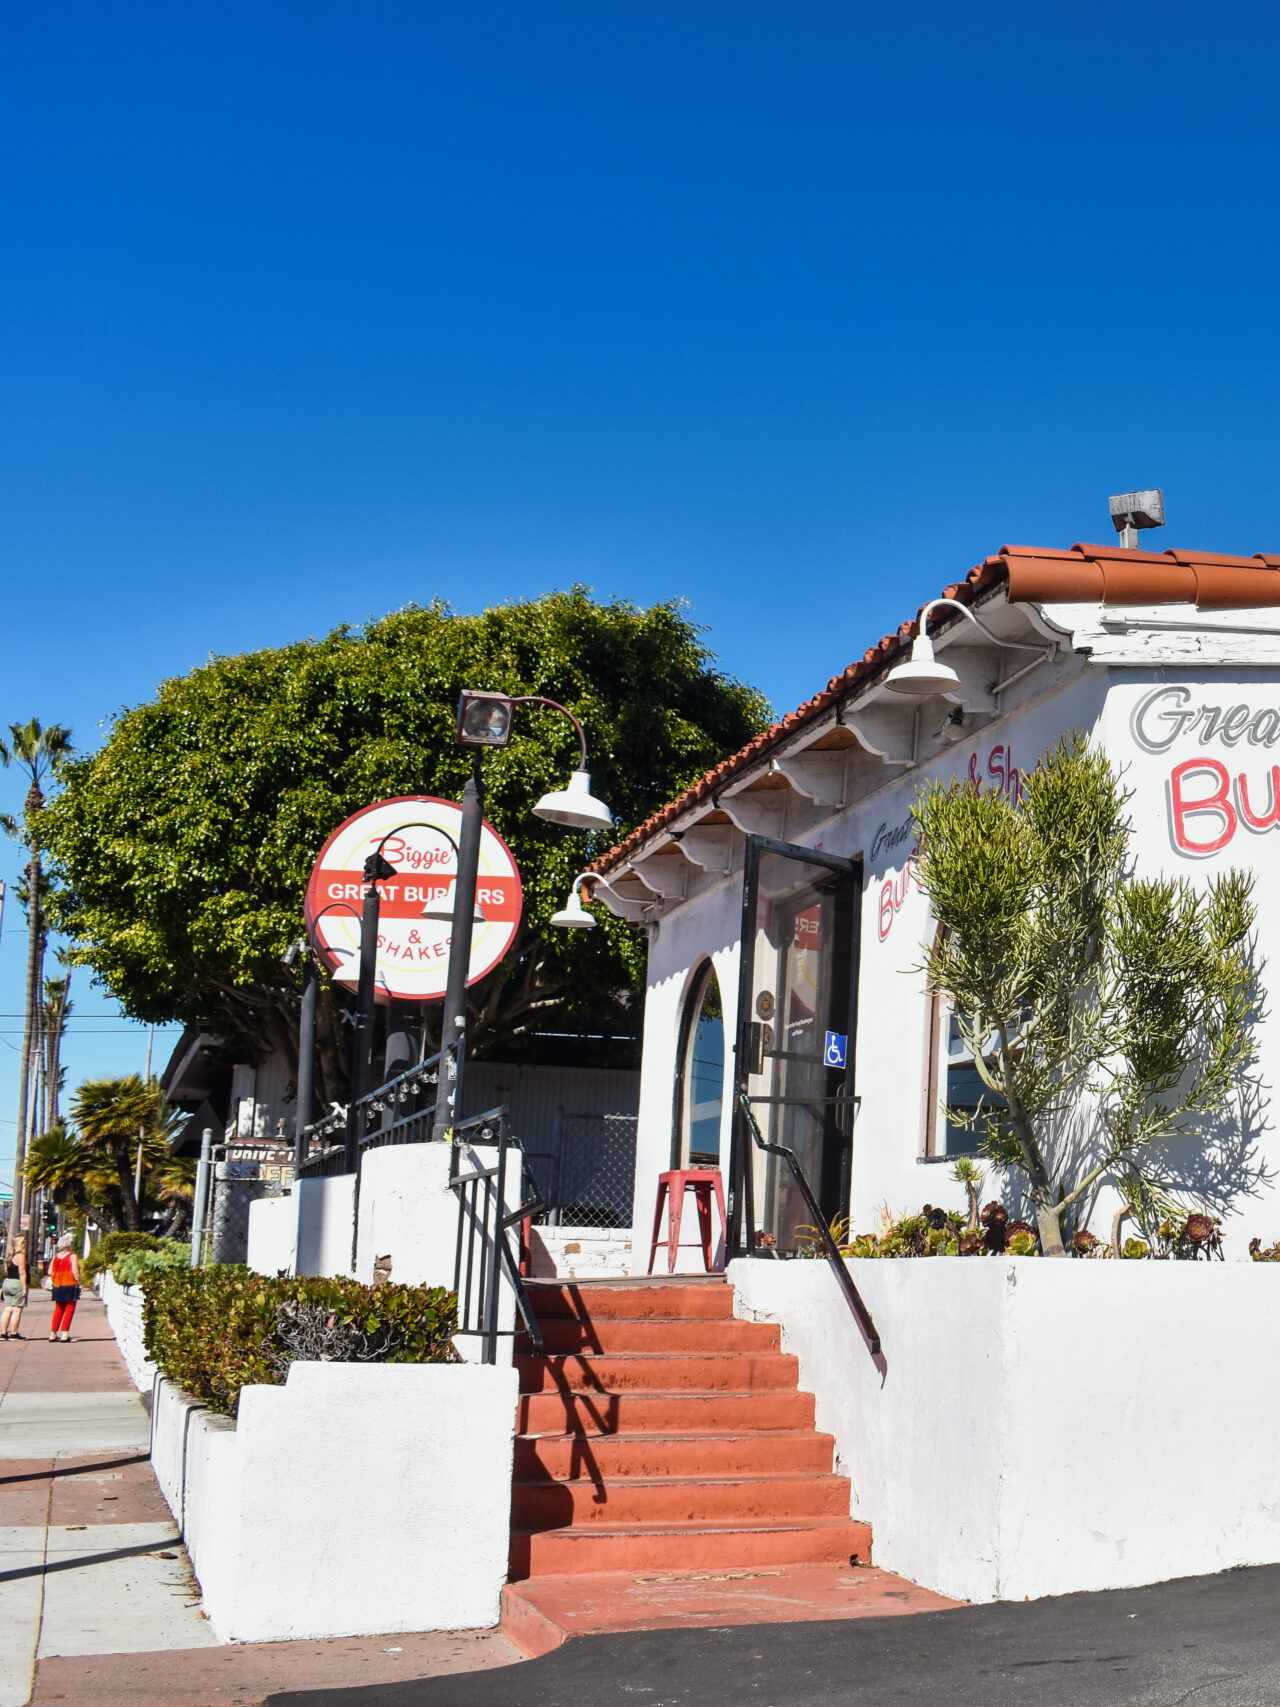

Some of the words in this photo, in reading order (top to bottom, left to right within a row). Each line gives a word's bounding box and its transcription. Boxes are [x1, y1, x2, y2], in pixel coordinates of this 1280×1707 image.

[327, 883, 400, 902] GREAT
[404, 886, 505, 905] BURRS
[408, 929, 422, 944] &
